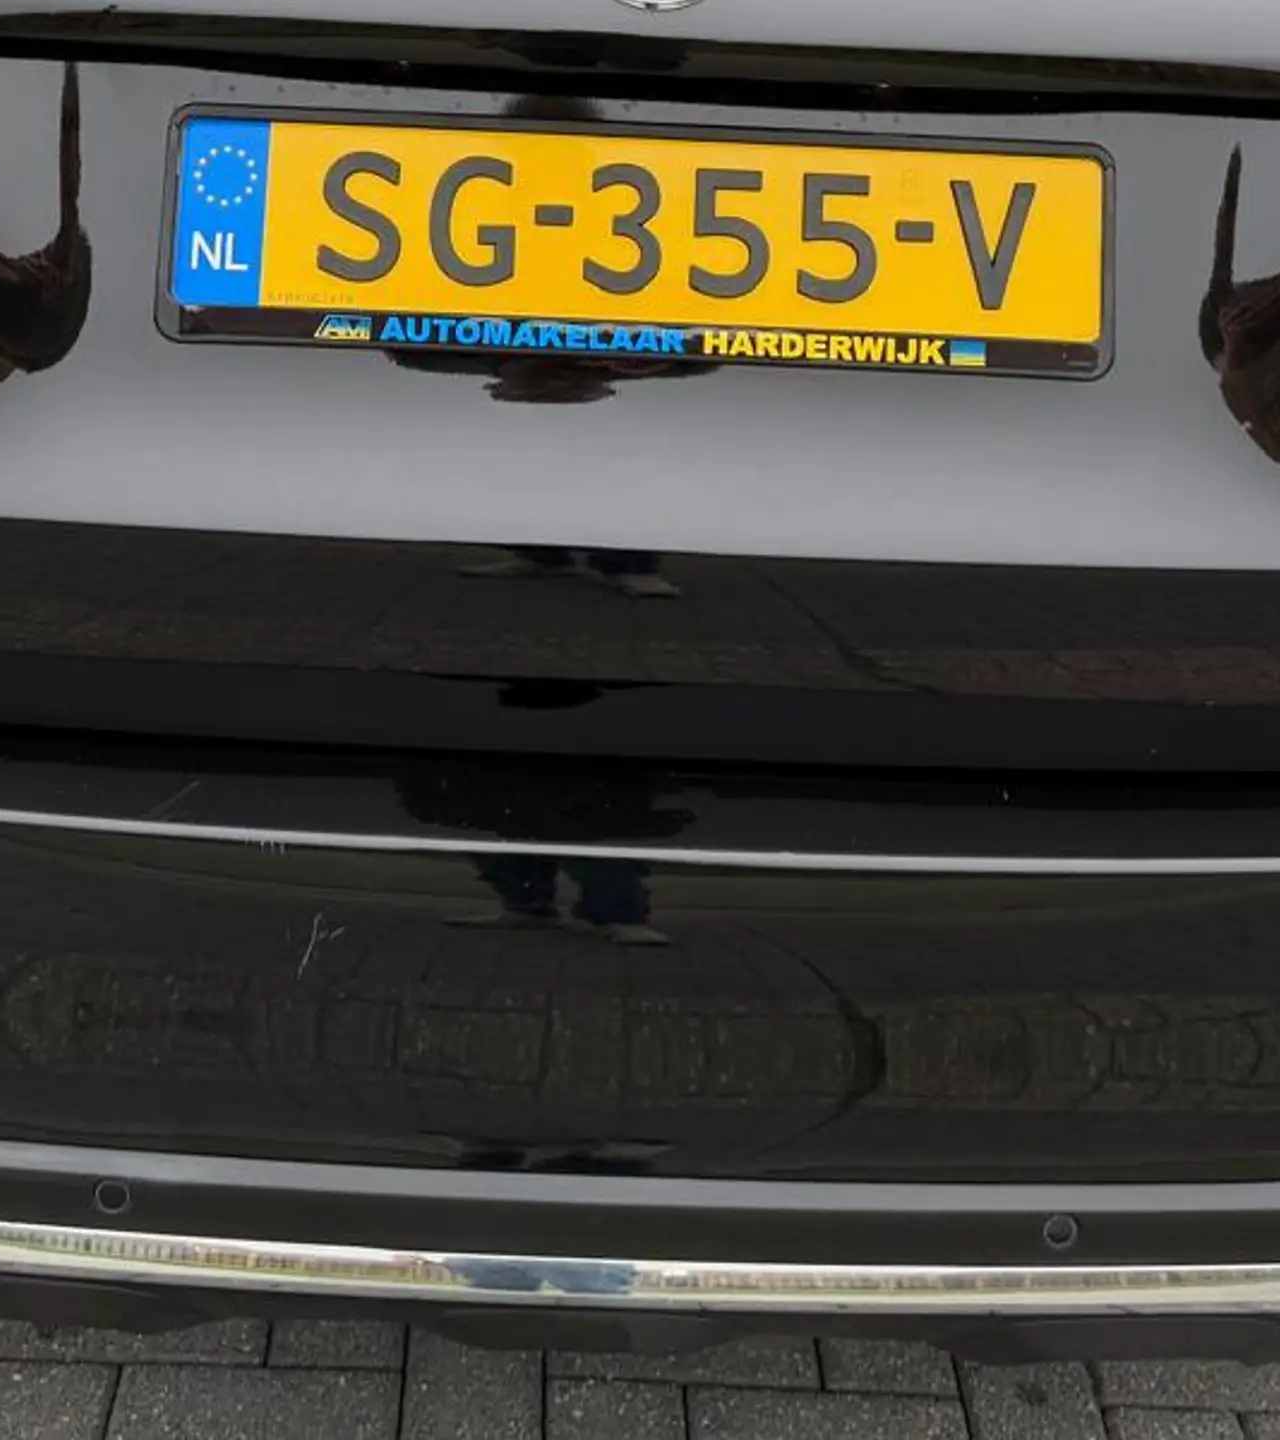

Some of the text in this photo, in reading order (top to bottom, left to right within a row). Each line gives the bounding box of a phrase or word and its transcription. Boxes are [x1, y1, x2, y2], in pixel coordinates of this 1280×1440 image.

[190, 230, 248, 273] NL
[317, 151, 1036, 310] SG-355-V
[380, 316, 685, 353] AUTOMAKELAAR
[703, 329, 946, 366] HARDERWIJK
